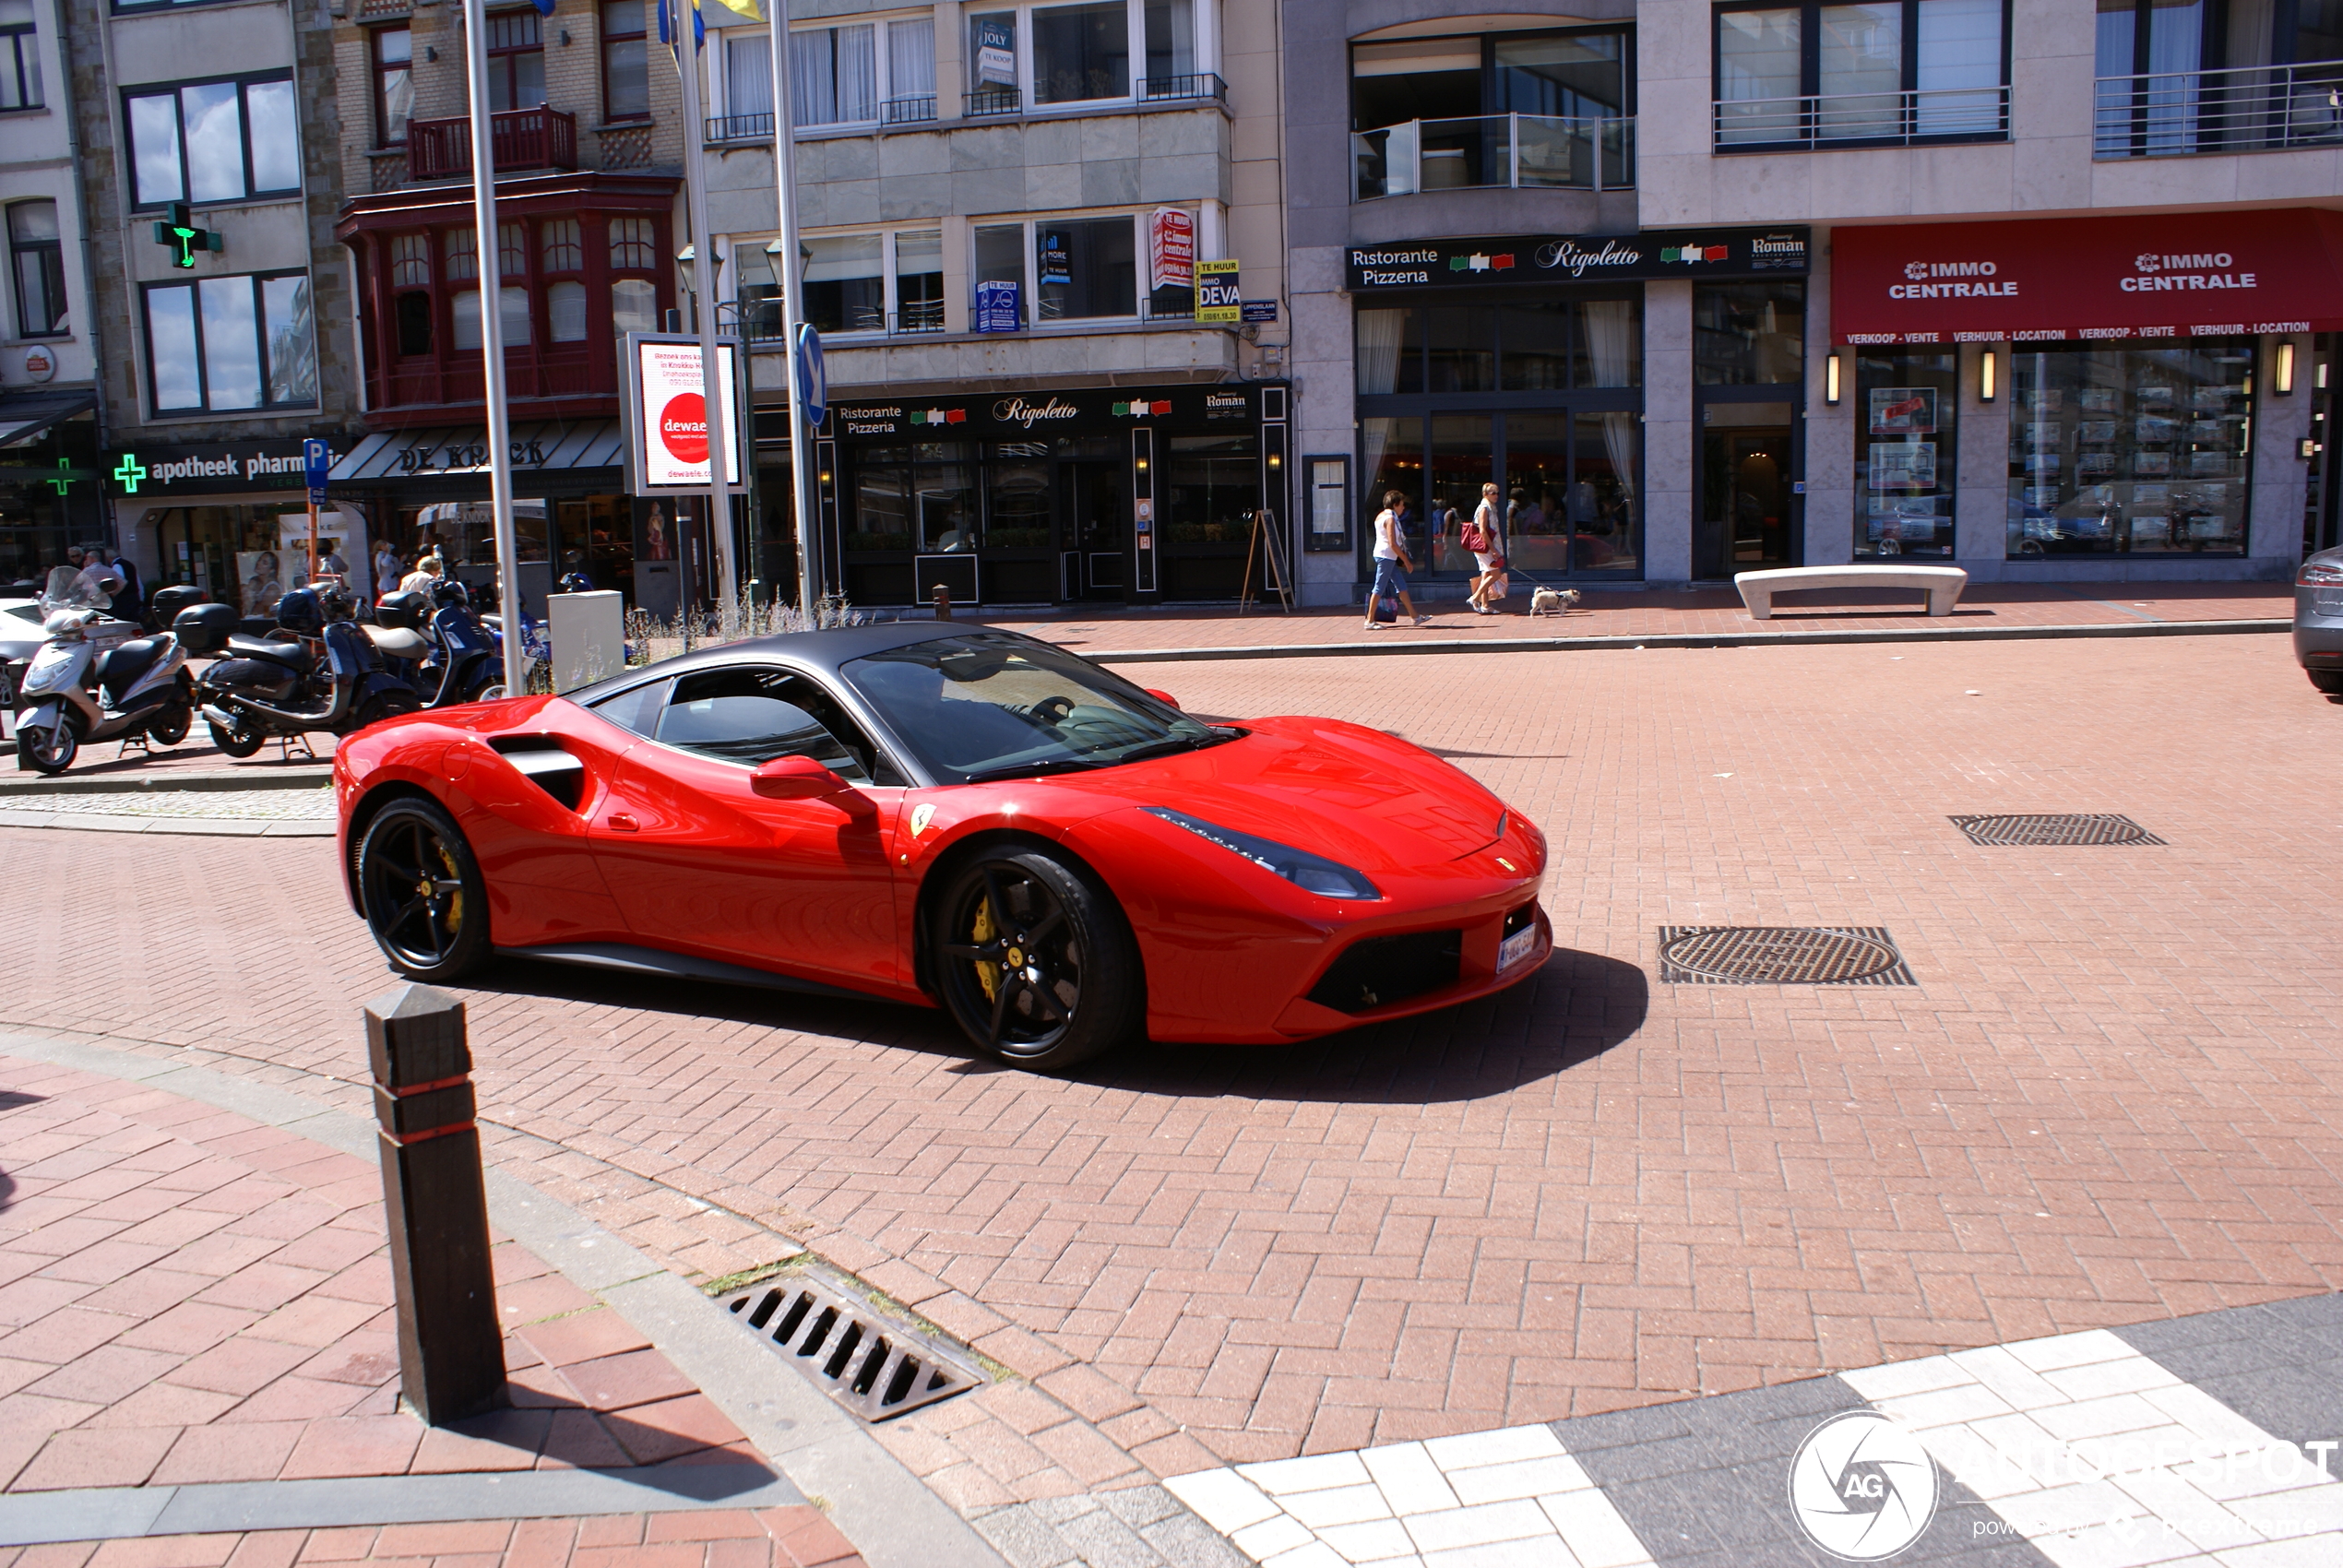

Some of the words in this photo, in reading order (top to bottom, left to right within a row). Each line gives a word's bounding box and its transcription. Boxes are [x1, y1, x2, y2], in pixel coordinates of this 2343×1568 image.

[983, 31, 1006, 46] JOLY
[985, 53, 993, 61] TE
[993, 55, 1011, 64] KOOP
[1165, 213, 1173, 223] TE
[1173, 215, 1190, 227] HUUR
[1047, 251, 1067, 260] MORE
[1164, 244, 1192, 257] centrale
[1352, 248, 1438, 266] Ristorante
[1535, 239, 1644, 278] Rigoletto
[1752, 238, 1805, 254] Roman
[1213, 263, 1237, 271] HUUR
[2162, 253, 2233, 269] IMMO
[1931, 261, 1997, 277] IMMO
[1200, 277, 1220, 286] IMMO
[1362, 269, 1429, 285] Pizzeria
[2120, 273, 2257, 291] CENTRALE
[1200, 285, 1241, 305] DEVA
[1889, 281, 2018, 299] CENTRALE
[1847, 333, 1897, 344] VERKOOP
[1905, 332, 1940, 343] VENTE
[1953, 331, 2004, 342] VERHUUR
[2013, 329, 2066, 341] LOCATION
[2079, 327, 2131, 339] VERKOOP
[2139, 327, 2176, 338] VENTE
[2190, 324, 2244, 336] VERHUUR
[2253, 321, 2311, 334] LOCATION
[840, 406, 902, 420] Ristorante
[993, 397, 1080, 429] Rigoletto
[1206, 395, 1246, 407] Roman
[664, 418, 708, 432] dewae
[848, 422, 896, 434] Pizzeria
[310, 443, 323, 469] P
[398, 446, 435, 471] DE
[152, 453, 239, 485] apotheek
[246, 448, 344, 481] pharmi
[667, 469, 712, 478] dewaele.co
[268, 478, 303, 488] VERS
[462, 510, 492, 524] KNOCK
